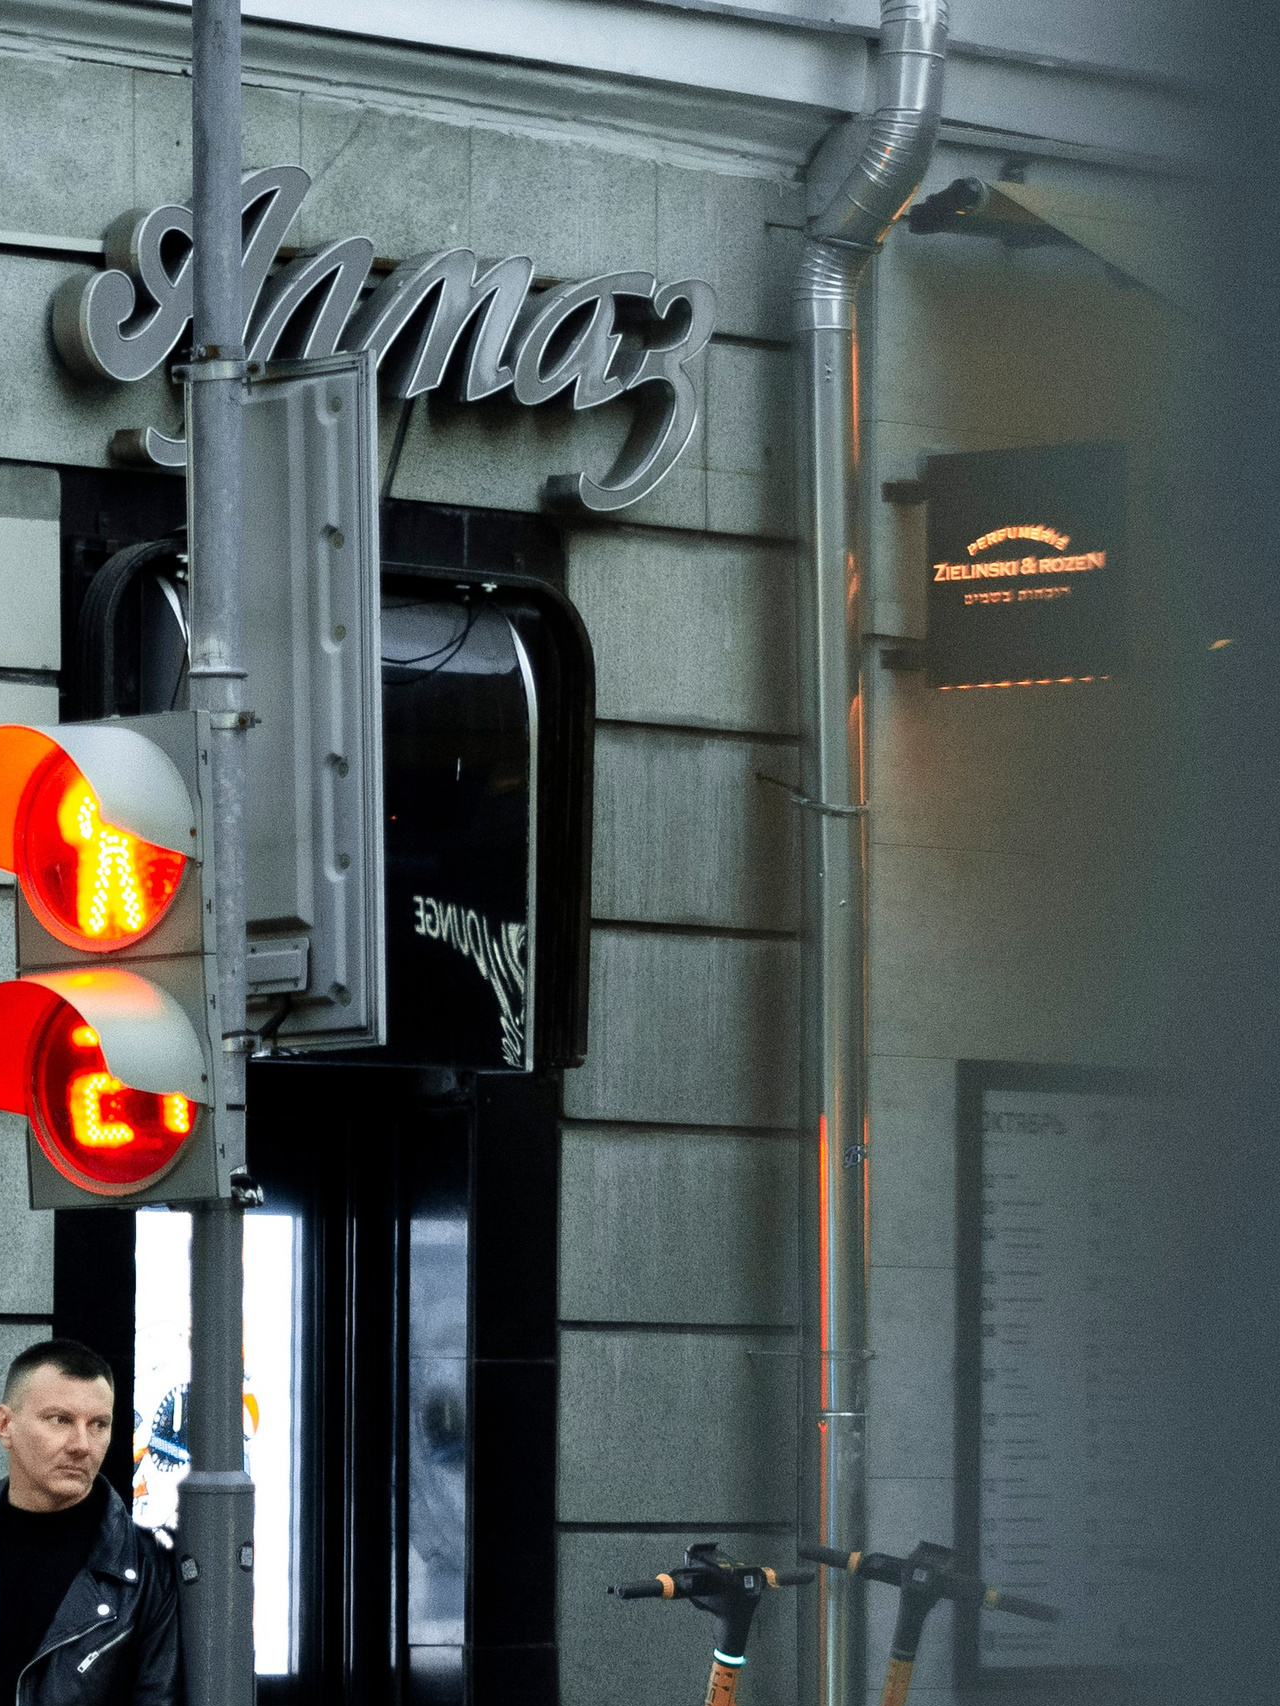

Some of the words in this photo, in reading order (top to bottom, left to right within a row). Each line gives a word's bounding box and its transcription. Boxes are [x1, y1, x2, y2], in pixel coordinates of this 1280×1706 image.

[933, 560, 1019, 582] ZIELINSKI
[1020, 555, 1037, 575] &
[1039, 551, 1107, 573] ROZEN
